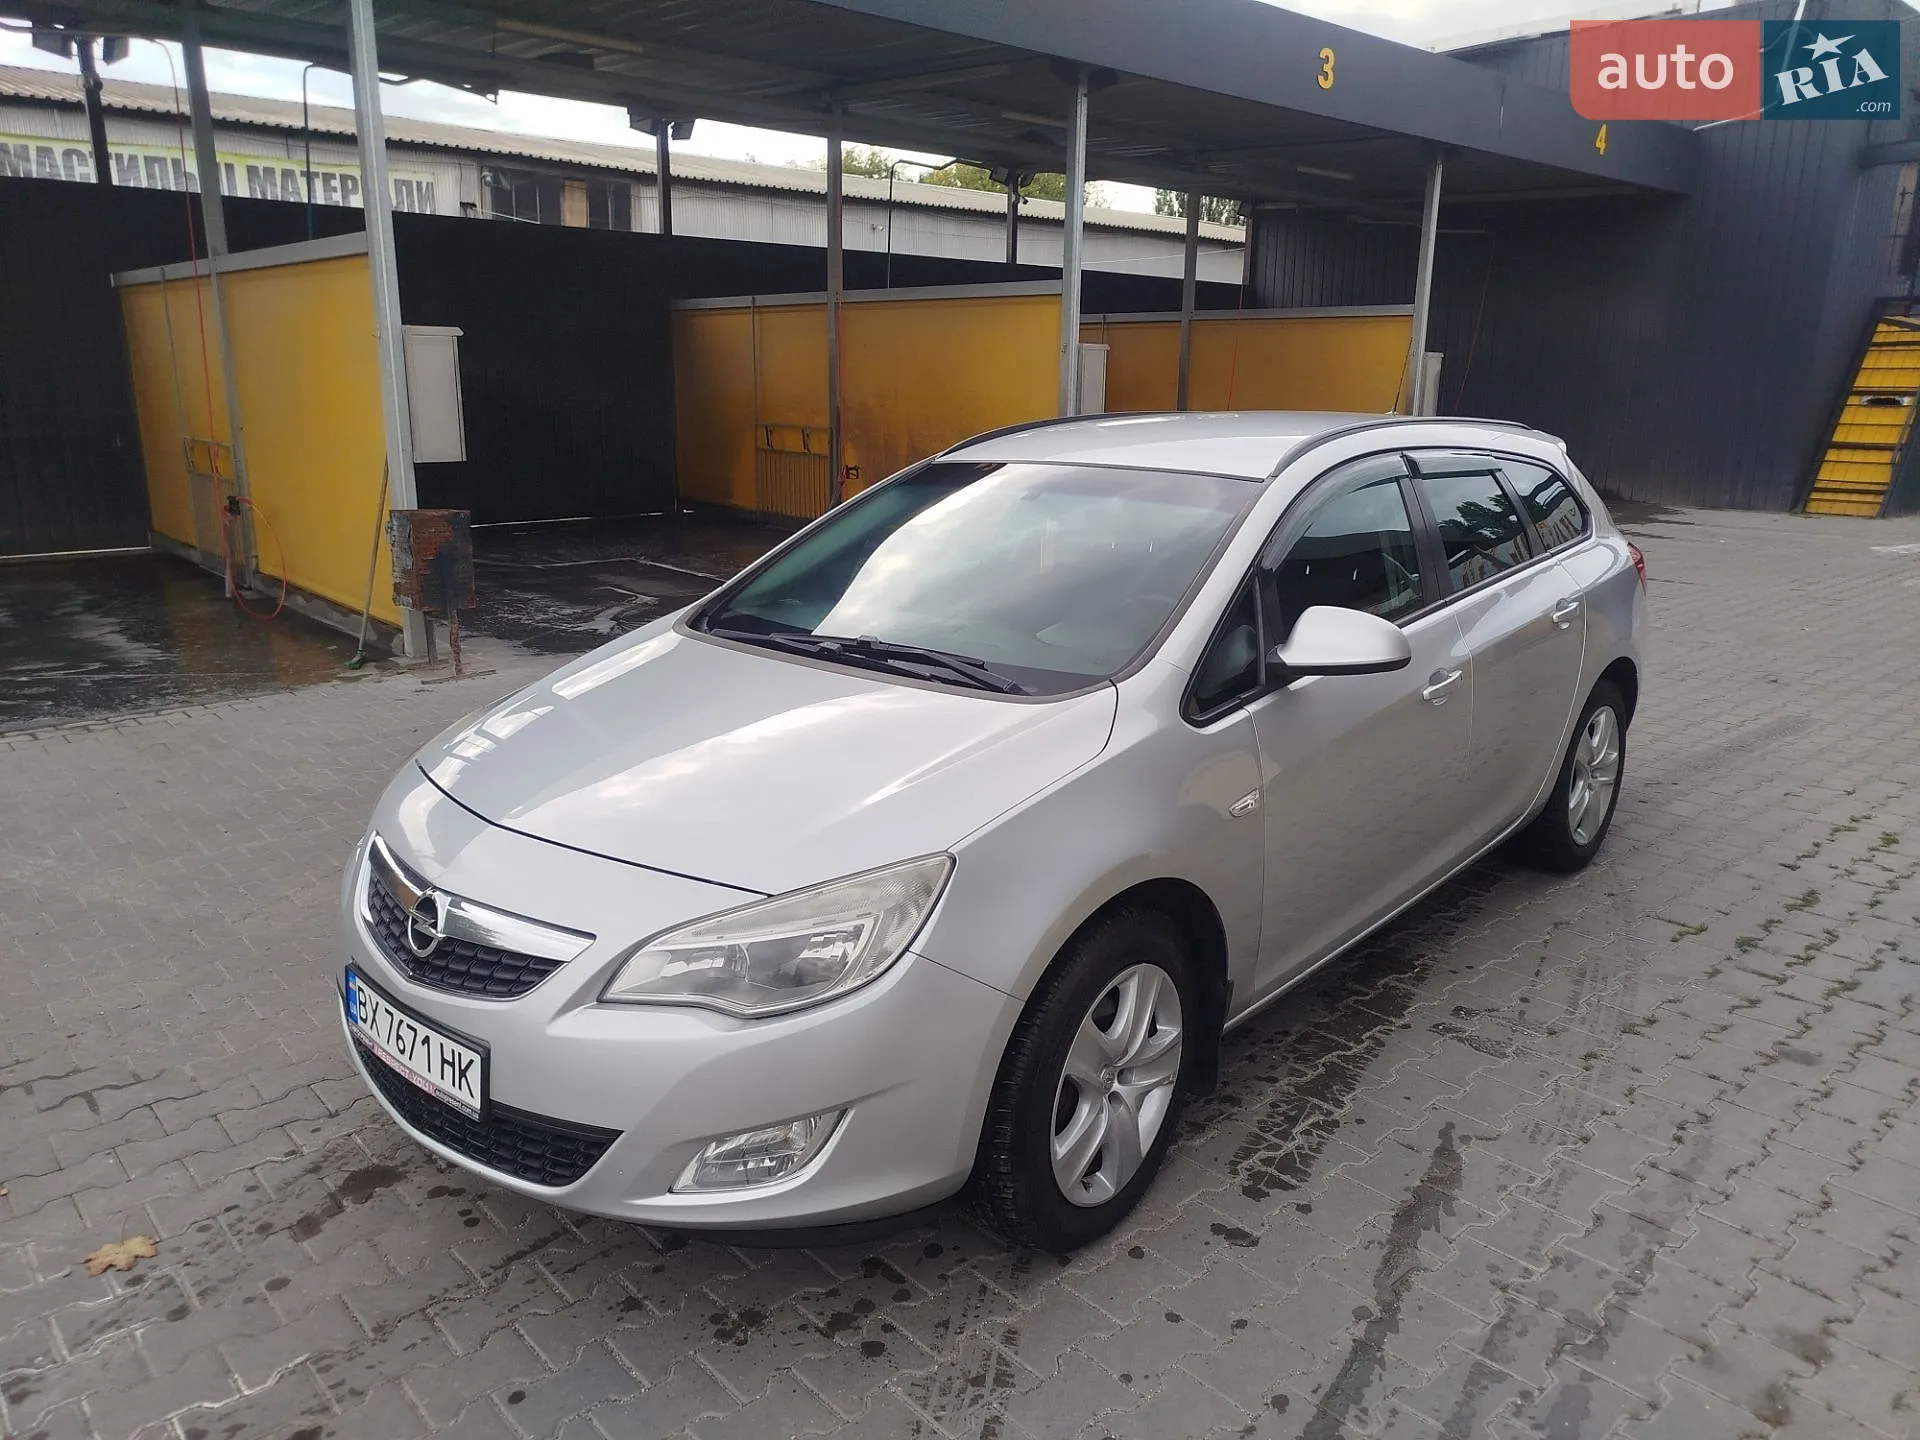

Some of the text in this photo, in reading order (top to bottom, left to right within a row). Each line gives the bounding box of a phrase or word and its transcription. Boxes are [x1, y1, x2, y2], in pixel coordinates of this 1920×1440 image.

[1316, 47, 1335, 89] 3
[1594, 123, 1607, 155] 4
[0, 142, 437, 215] МАСИЛЬІ МАТЕРЛИ
[357, 985, 475, 1099] BX 7671 HK
